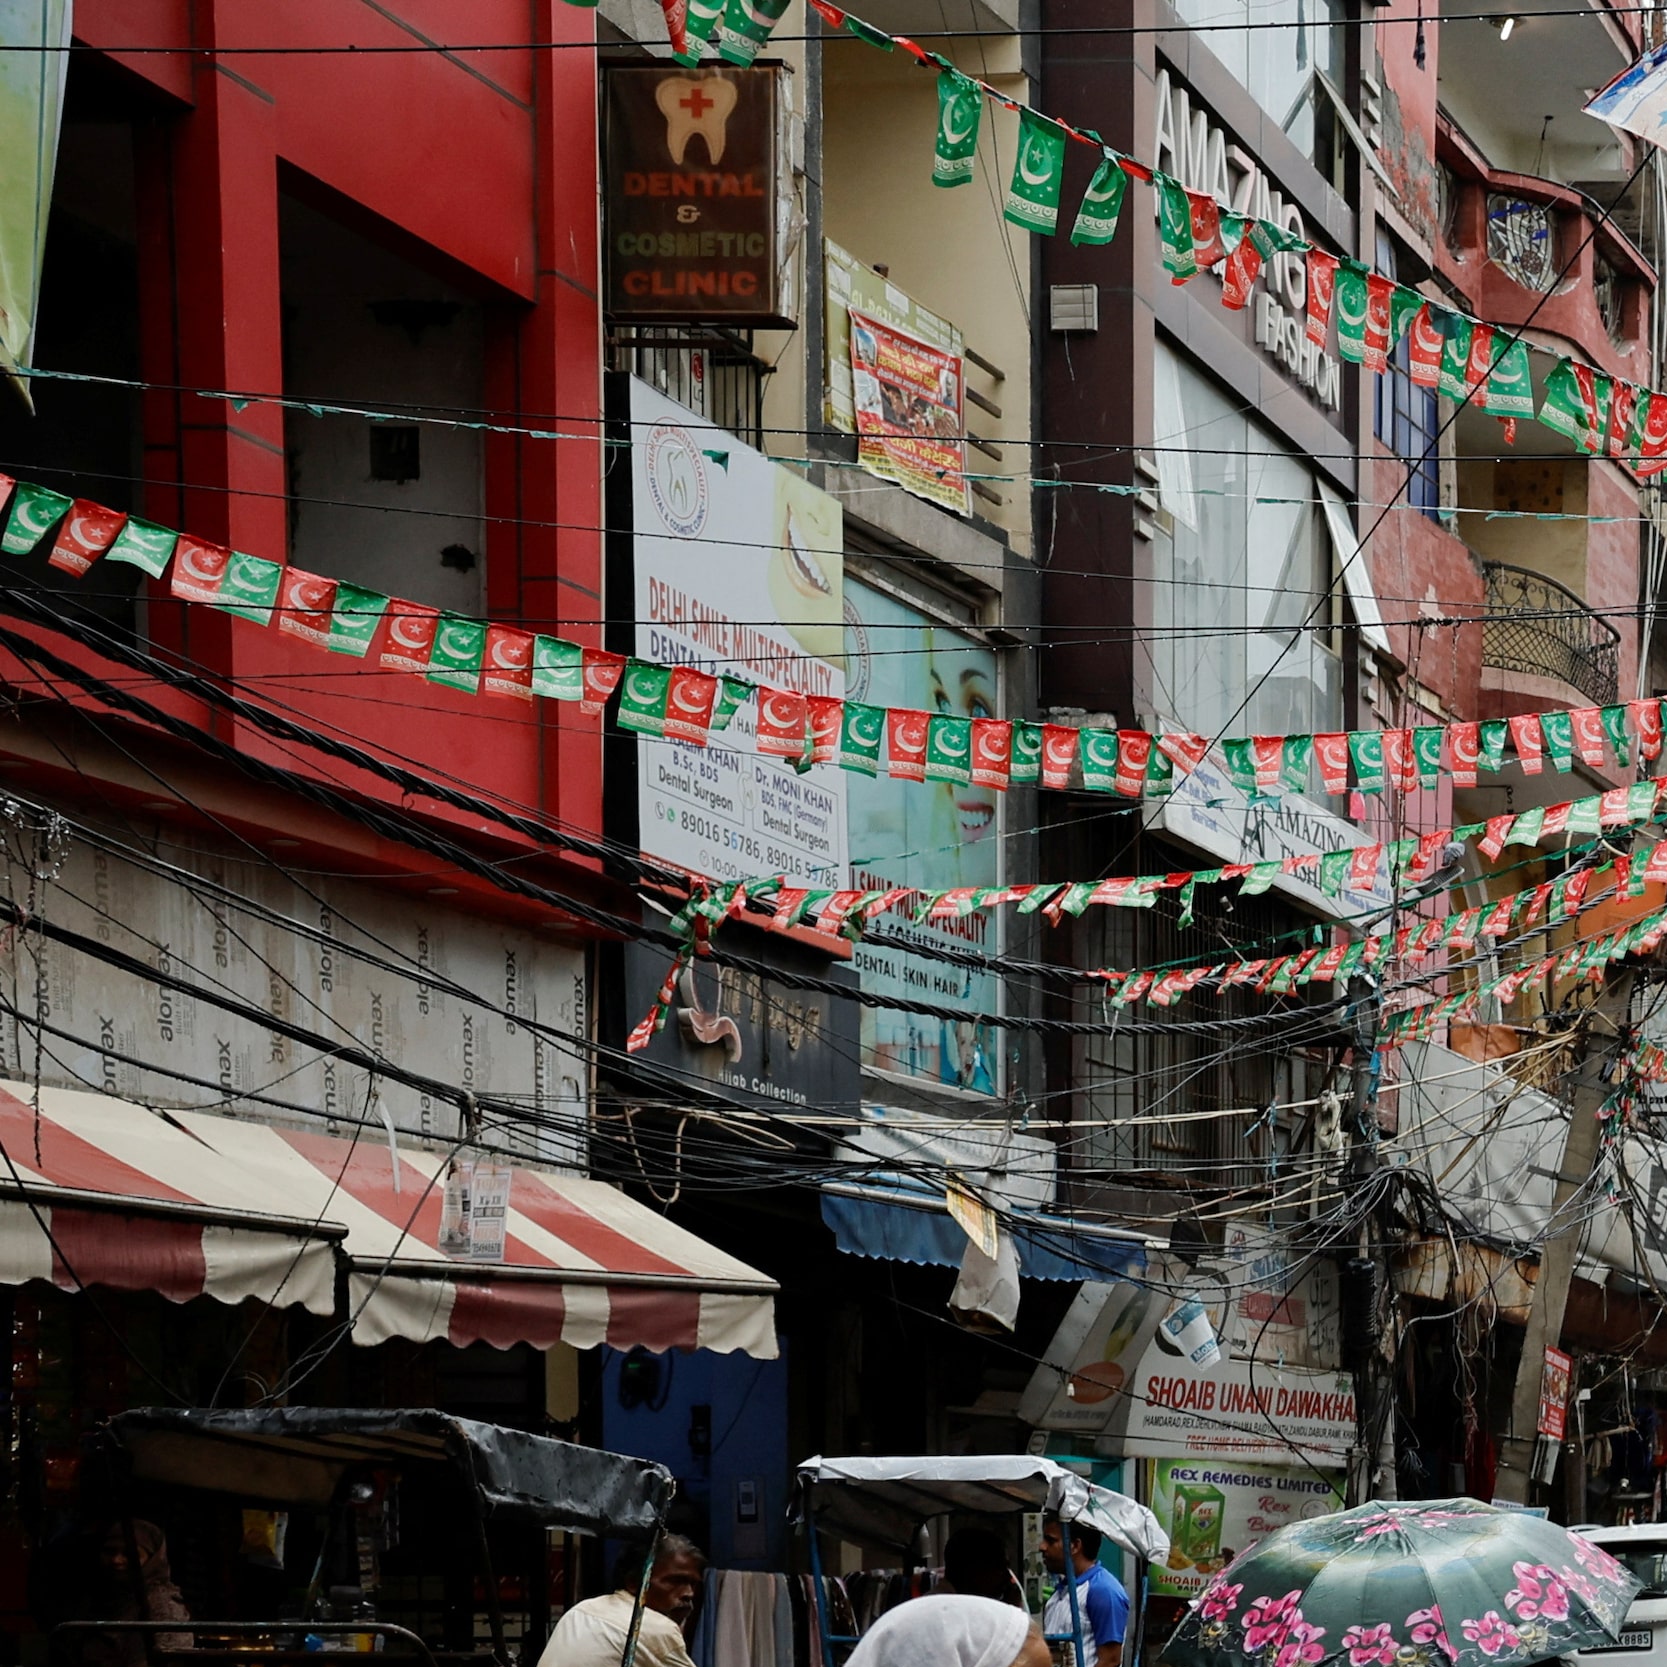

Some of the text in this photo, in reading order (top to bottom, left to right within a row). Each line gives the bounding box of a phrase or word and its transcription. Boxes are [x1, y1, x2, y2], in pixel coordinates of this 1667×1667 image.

[624, 172, 764, 197] DENTAL
[1154, 68, 1306, 310] AMAZING
[676, 205, 701, 223] &
[617, 232, 765, 257] COSMETIC
[623, 271, 757, 296] CLINIC
[1256, 291, 1341, 412] FASHION
[649, 576, 688, 636] DELHI
[691, 599, 729, 657] SMILE
[733, 620, 832, 698] MULTISPECIALITY
[699, 763, 720, 784] BDS
[706, 746, 740, 774] KHAN
[658, 764, 734, 813] Dental Surgeon
[755, 766, 833, 815] Dr. MONI KHAN
[681, 810, 721, 844] 89016
[722, 827, 765, 866] 56786,
[766, 846, 803, 877] 89016
[762, 809, 830, 853] Dental Surgeon
[1274, 806, 1346, 853] AMAZING
[855, 952, 960, 999] DENTAL SKIN HAIR
[751, 1077, 807, 1105] Collection
[1146, 1374, 1358, 1423] SHOAIB UNANI DAWAKHA
[1186, 1434, 1267, 1454] FREE HOME DELIVERY
[1170, 1467, 1334, 1495] REX REMEDIES LIMITED
[1258, 1496, 1291, 1514] Rex
[1158, 1574, 1201, 1587] SHOAIB
